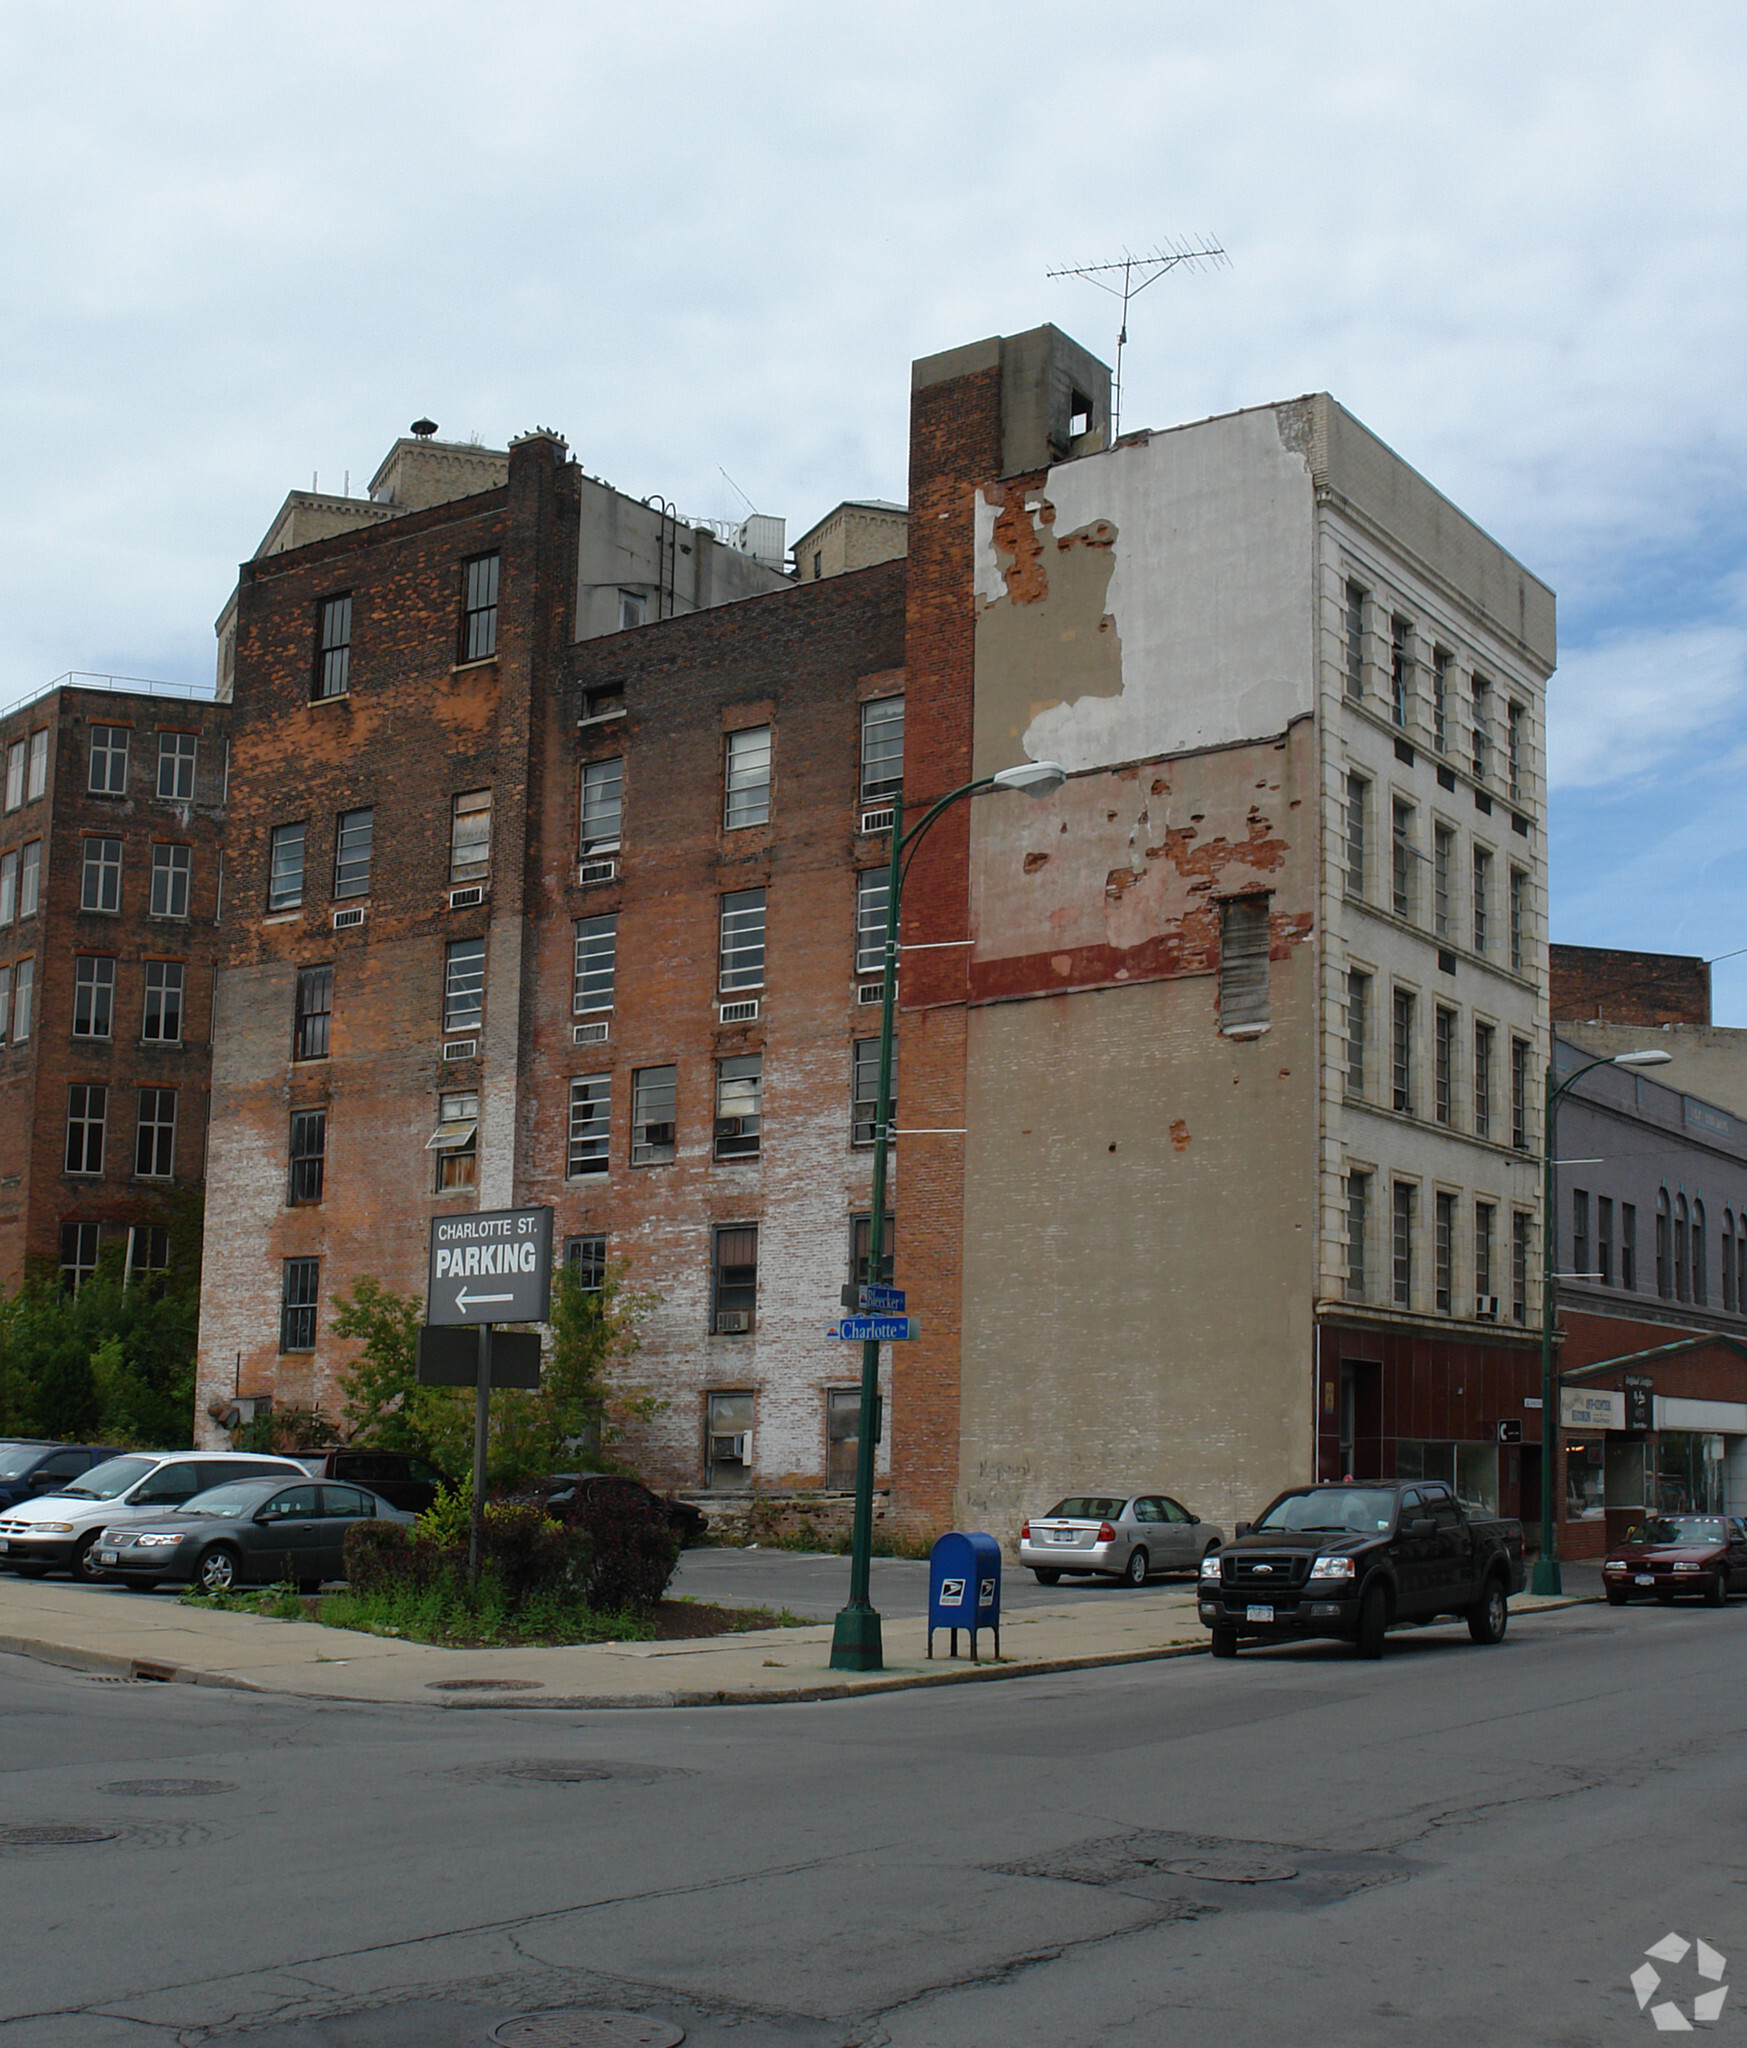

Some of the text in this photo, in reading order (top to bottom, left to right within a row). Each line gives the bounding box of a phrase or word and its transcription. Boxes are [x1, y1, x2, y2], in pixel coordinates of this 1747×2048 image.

[438, 1217, 538, 1240] CHARLOTTE ST.
[436, 1242, 536, 1278] PARKING
[841, 1320, 897, 1340] Charlotte
